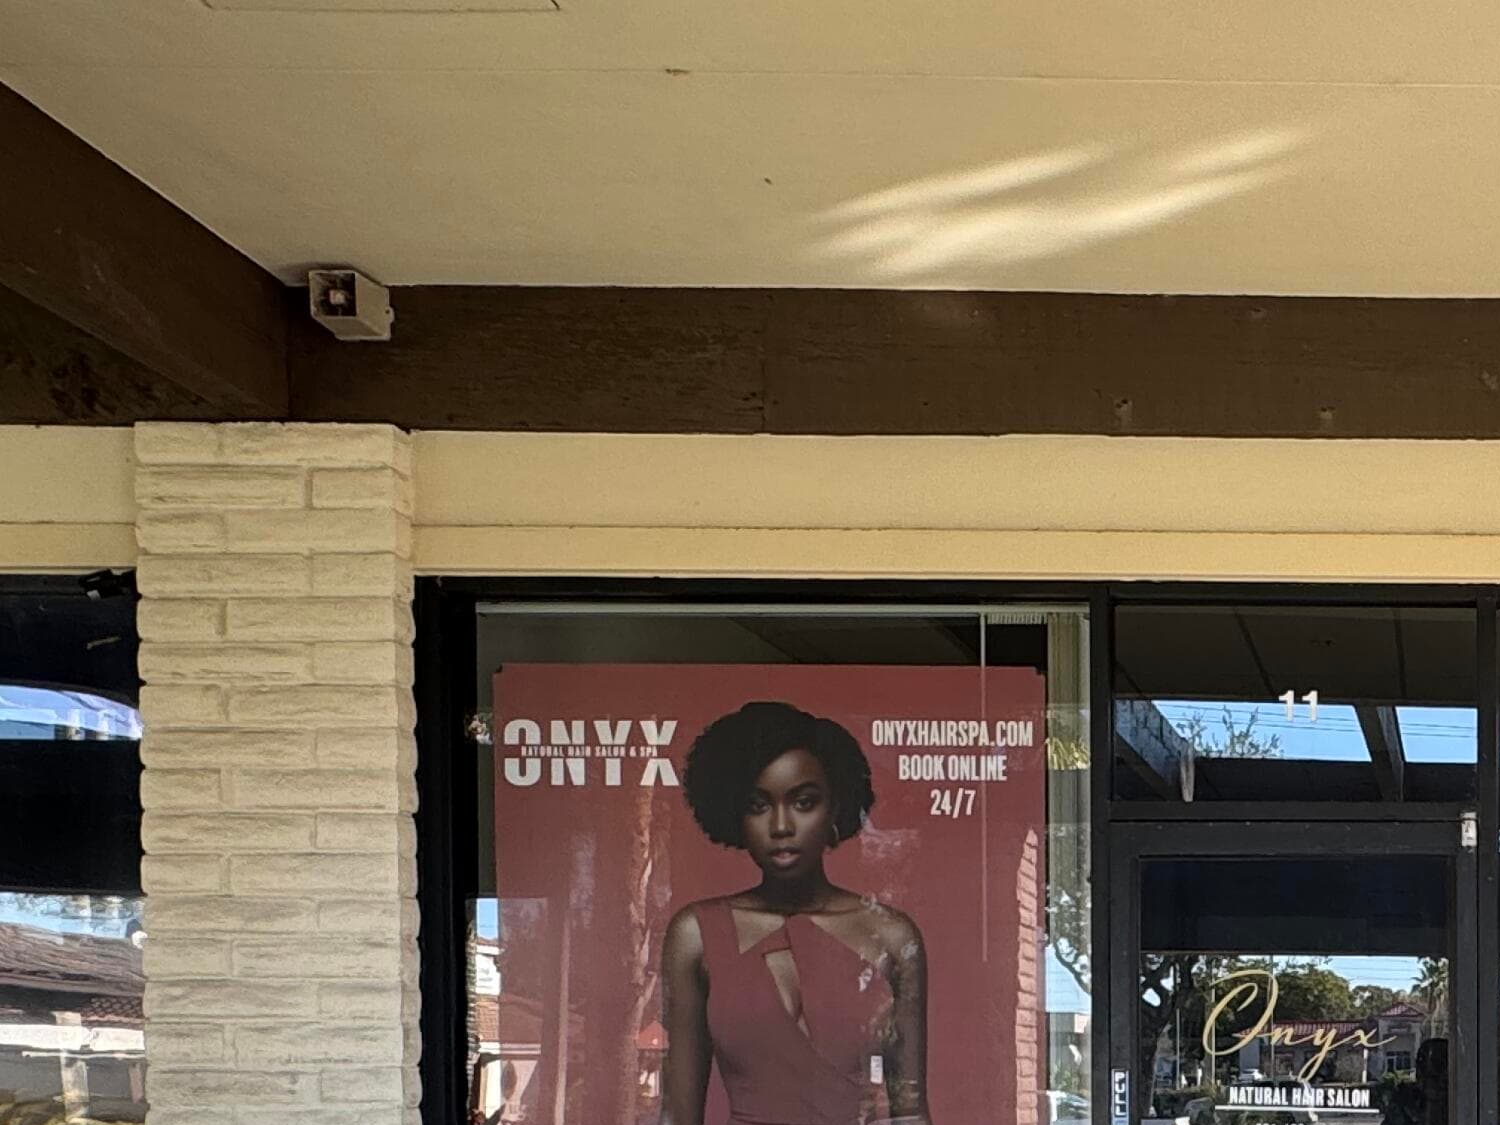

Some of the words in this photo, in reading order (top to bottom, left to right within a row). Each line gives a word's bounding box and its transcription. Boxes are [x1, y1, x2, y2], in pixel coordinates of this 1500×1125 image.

[1278, 690, 1318, 721] 11
[872, 720, 1033, 747] ONYXHAIRSPA.COM
[504, 719, 680, 786] ONYX
[521, 746, 565, 757] NATURAL
[567, 746, 591, 757] HAIR
[595, 746, 626, 757] SALON
[629, 746, 637, 757] &
[640, 746, 658, 757] SPA
[899, 755, 945, 780] BOOK
[948, 755, 1008, 781] ONLINE
[930, 788, 976, 819] 24/7
[1202, 969, 1397, 1083] Onyx
[1113, 1070, 1127, 1117] PULL
[1229, 1086, 1288, 1105] NATURAL
[1292, 1088, 1325, 1107] HAIR
[1328, 1088, 1370, 1107] SALON
